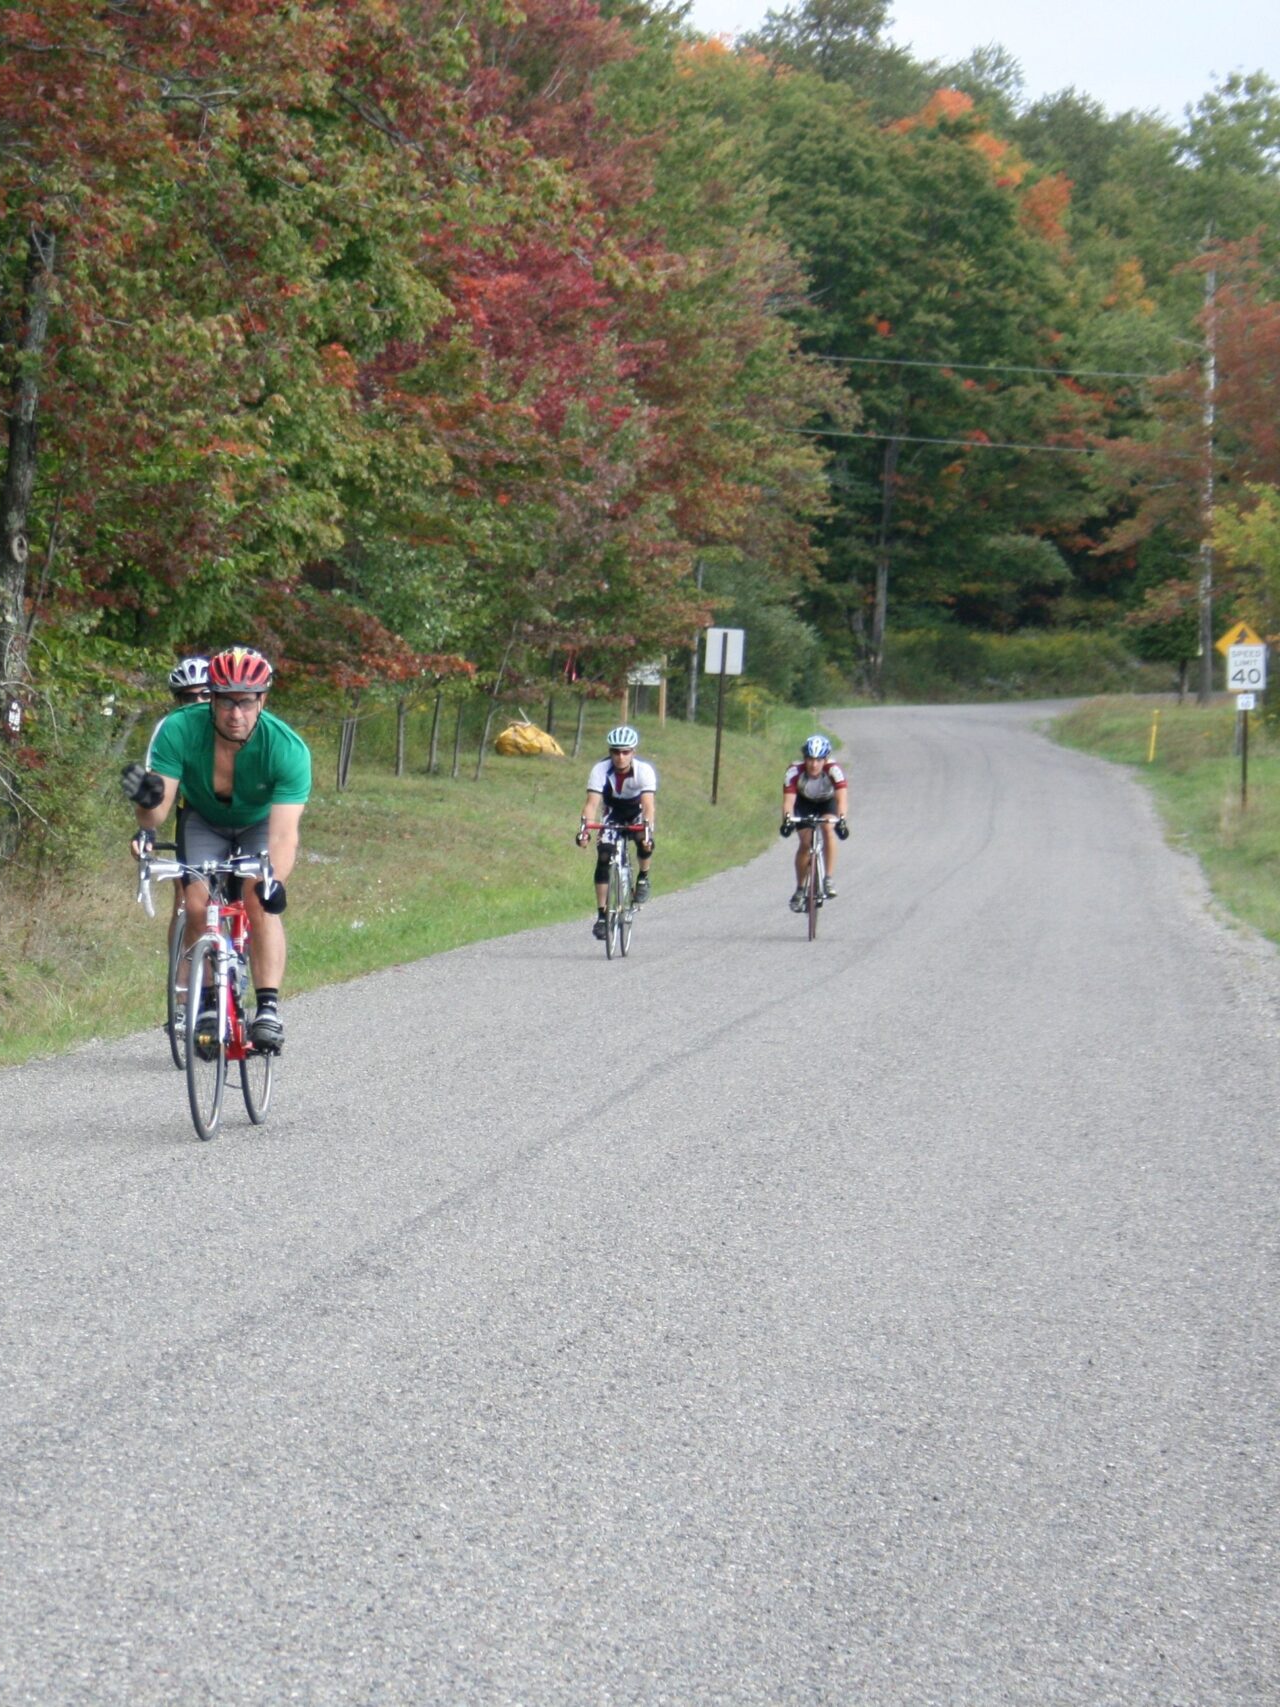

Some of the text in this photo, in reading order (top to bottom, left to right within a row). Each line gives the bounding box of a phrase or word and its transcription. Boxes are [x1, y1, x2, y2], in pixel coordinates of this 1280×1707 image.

[1231, 650, 1261, 658] SPEED
[1234, 659, 1258, 667] LIMIT
[1231, 668, 1261, 684] 40
